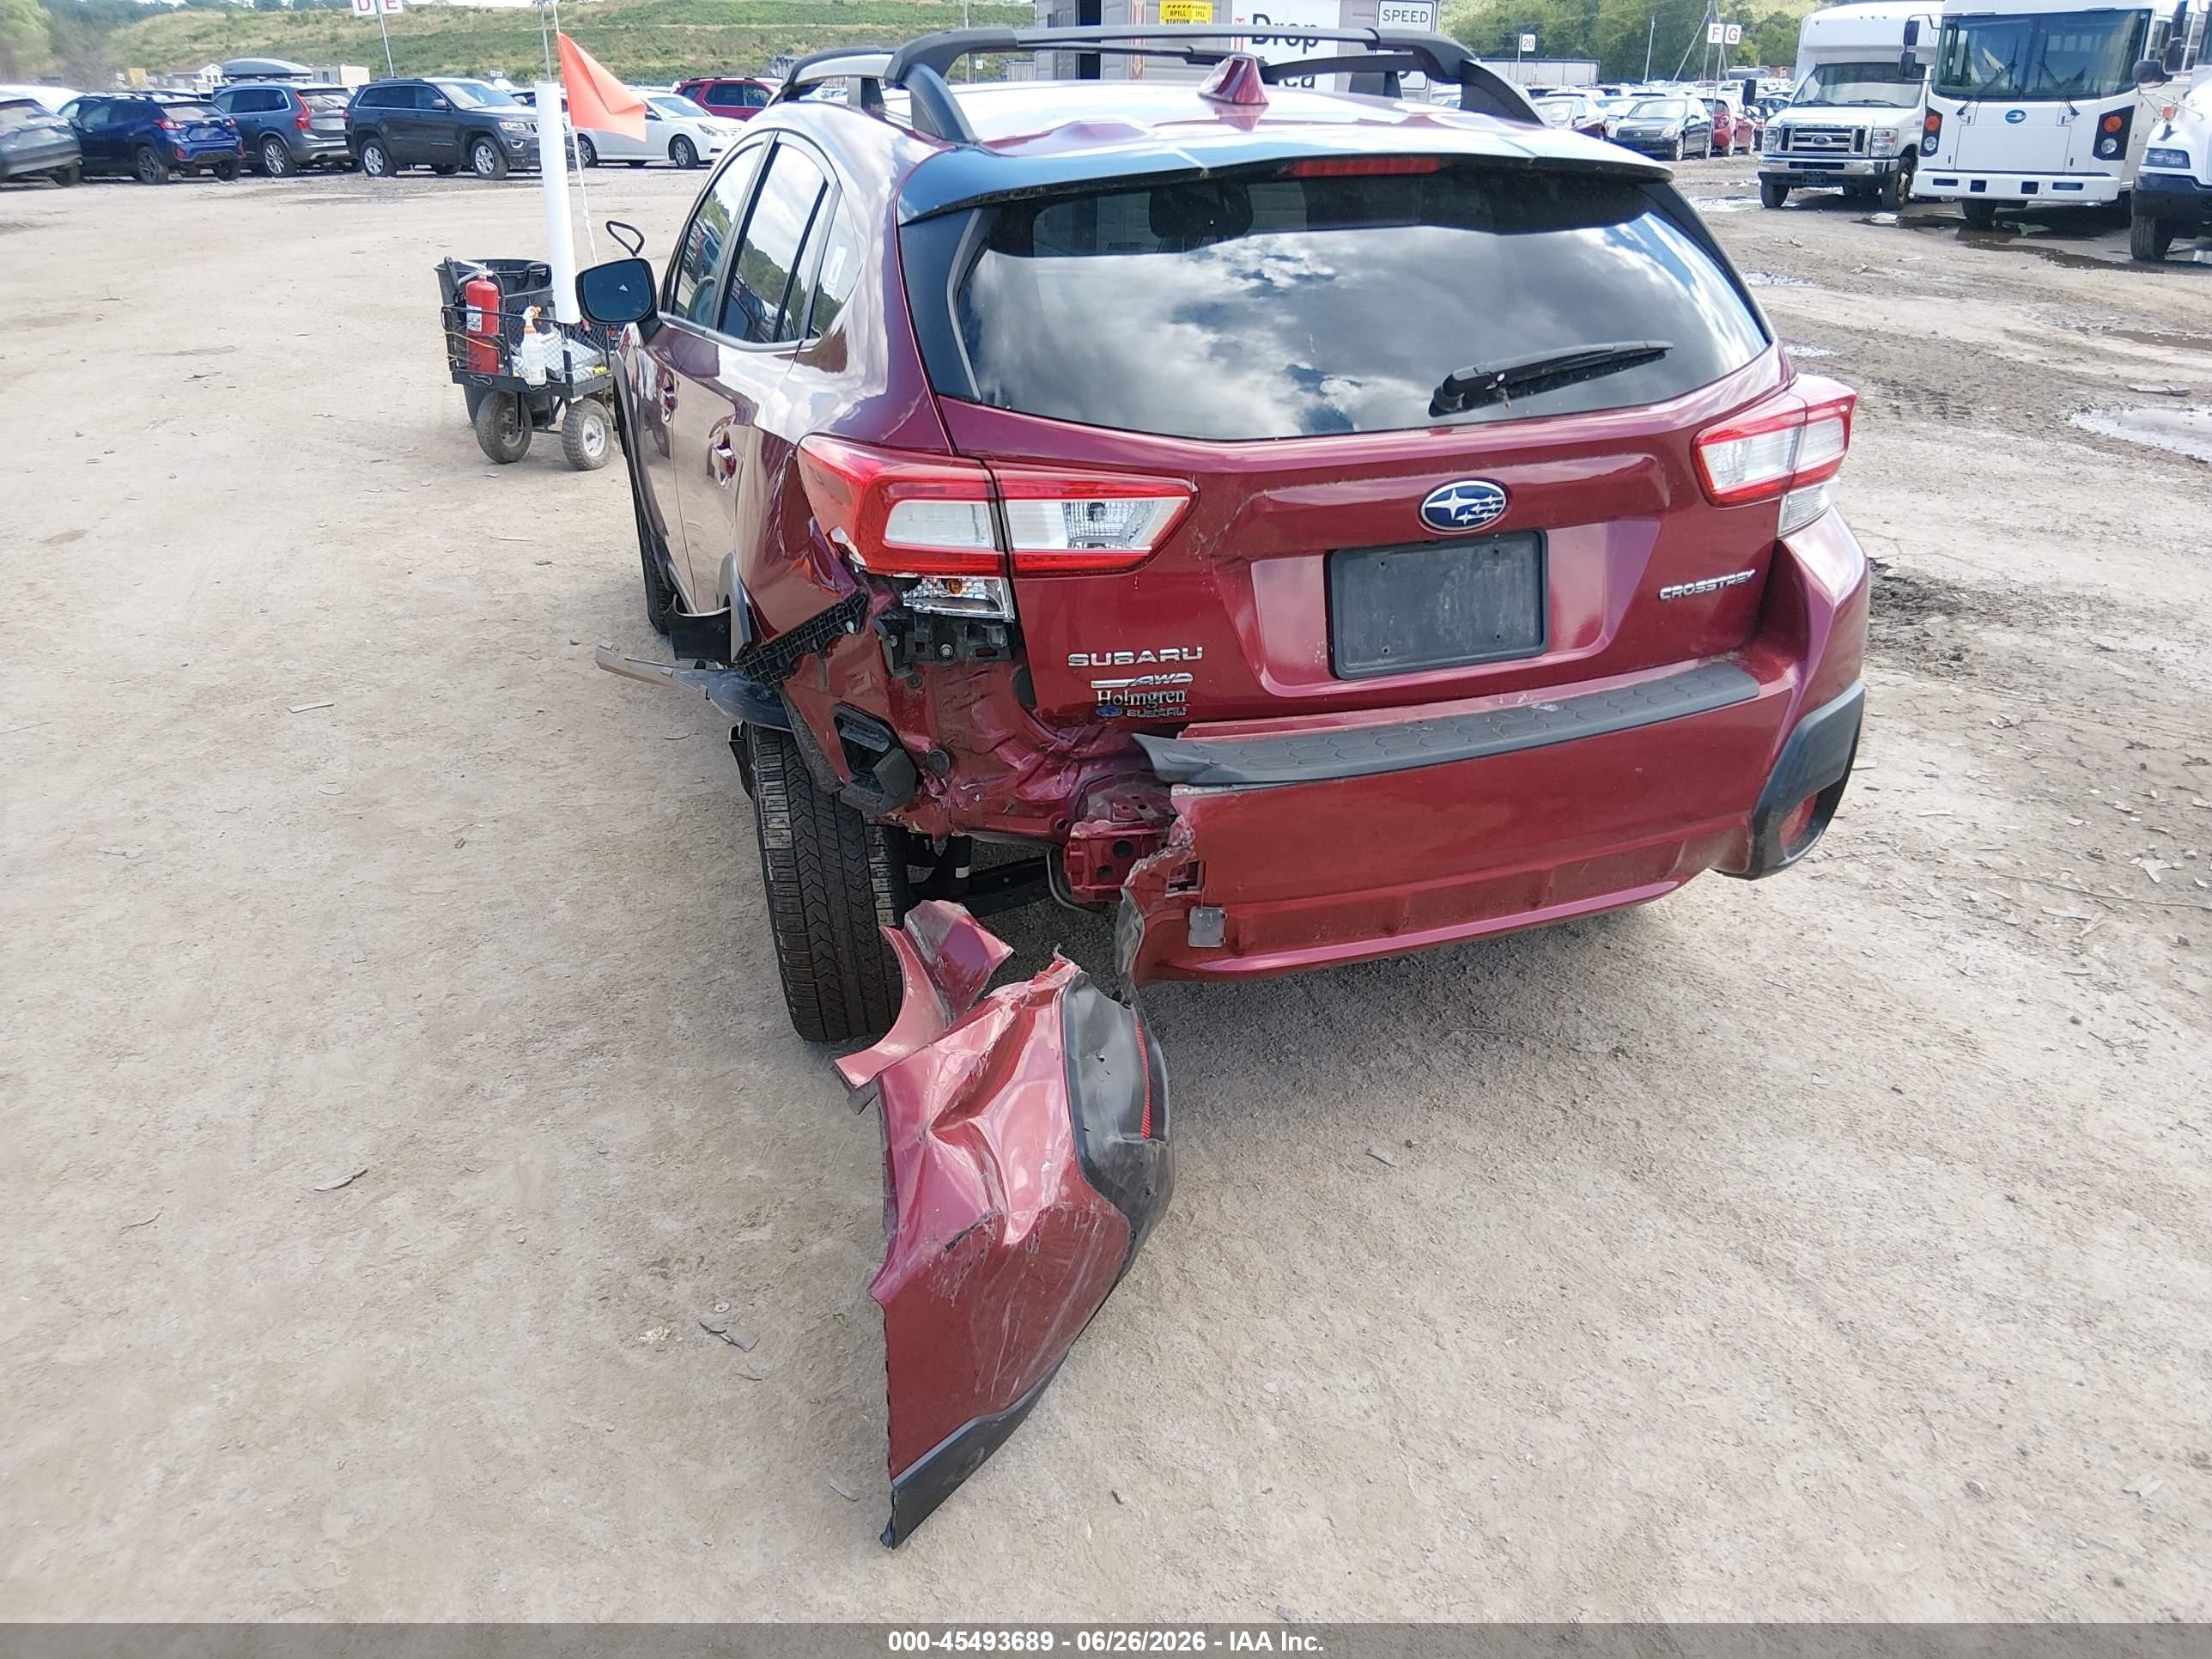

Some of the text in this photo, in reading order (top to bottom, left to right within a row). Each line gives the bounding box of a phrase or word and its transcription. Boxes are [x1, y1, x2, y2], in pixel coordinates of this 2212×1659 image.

[1382, 9, 1429, 23] SPEED
[1711, 27, 1721, 40] F
[1728, 27, 1738, 41] G
[1522, 39, 1534, 48] 20
[1067, 647, 1203, 666] SUBARU
[1129, 672, 1194, 686] AWD
[1097, 689, 1187, 708] Holmgren
